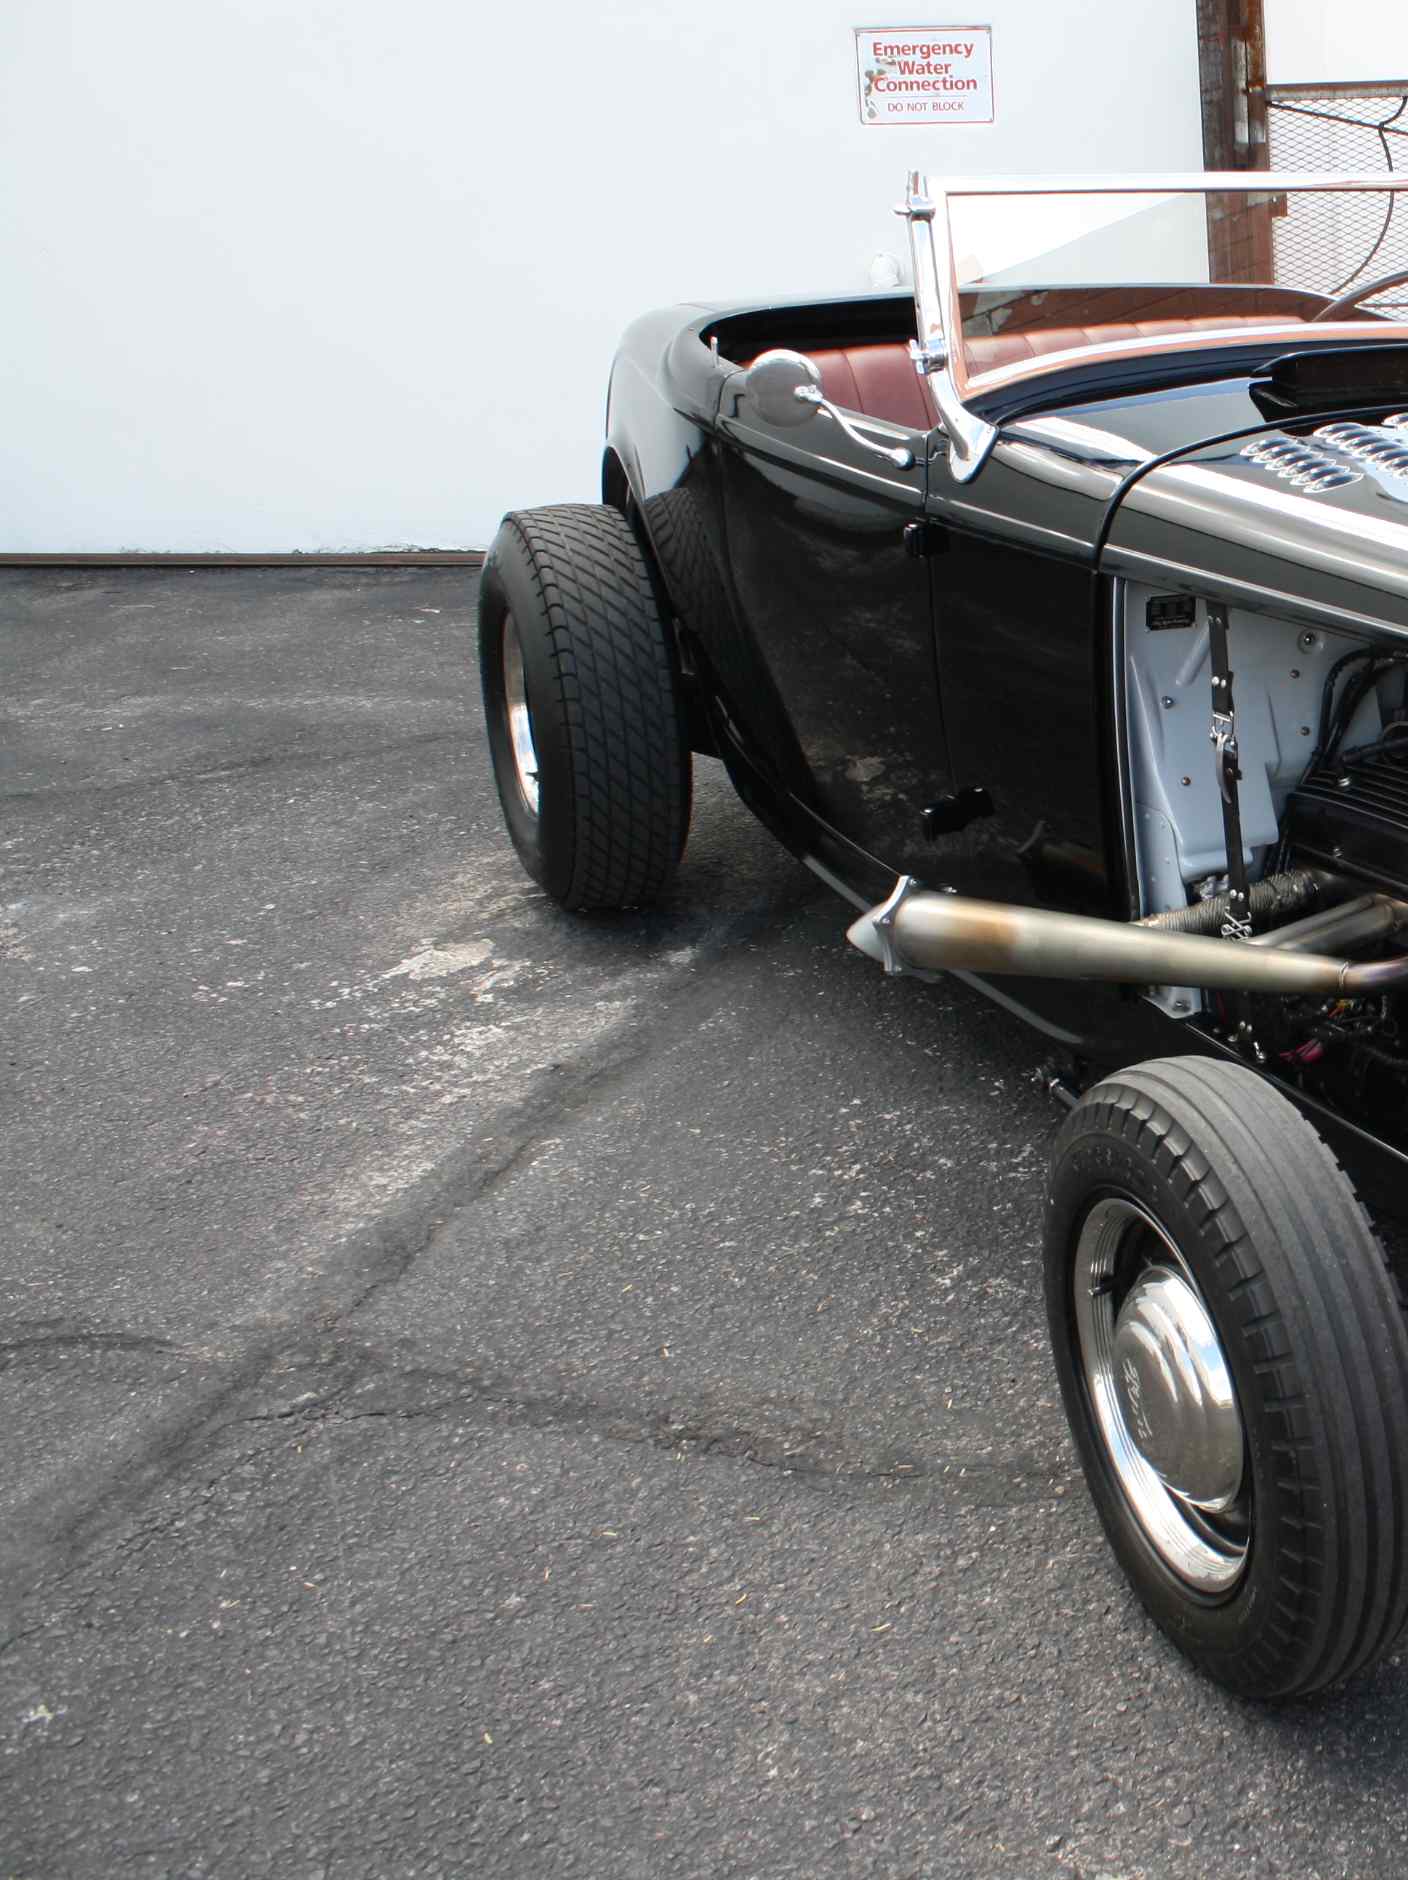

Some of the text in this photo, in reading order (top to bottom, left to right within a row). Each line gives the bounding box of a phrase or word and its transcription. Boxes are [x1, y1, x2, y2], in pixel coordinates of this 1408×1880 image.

[872, 42, 974, 59] Emergency
[896, 60, 952, 75] Water
[873, 75, 978, 92] Connection
[887, 101, 965, 113] DO NOT BLOCK
